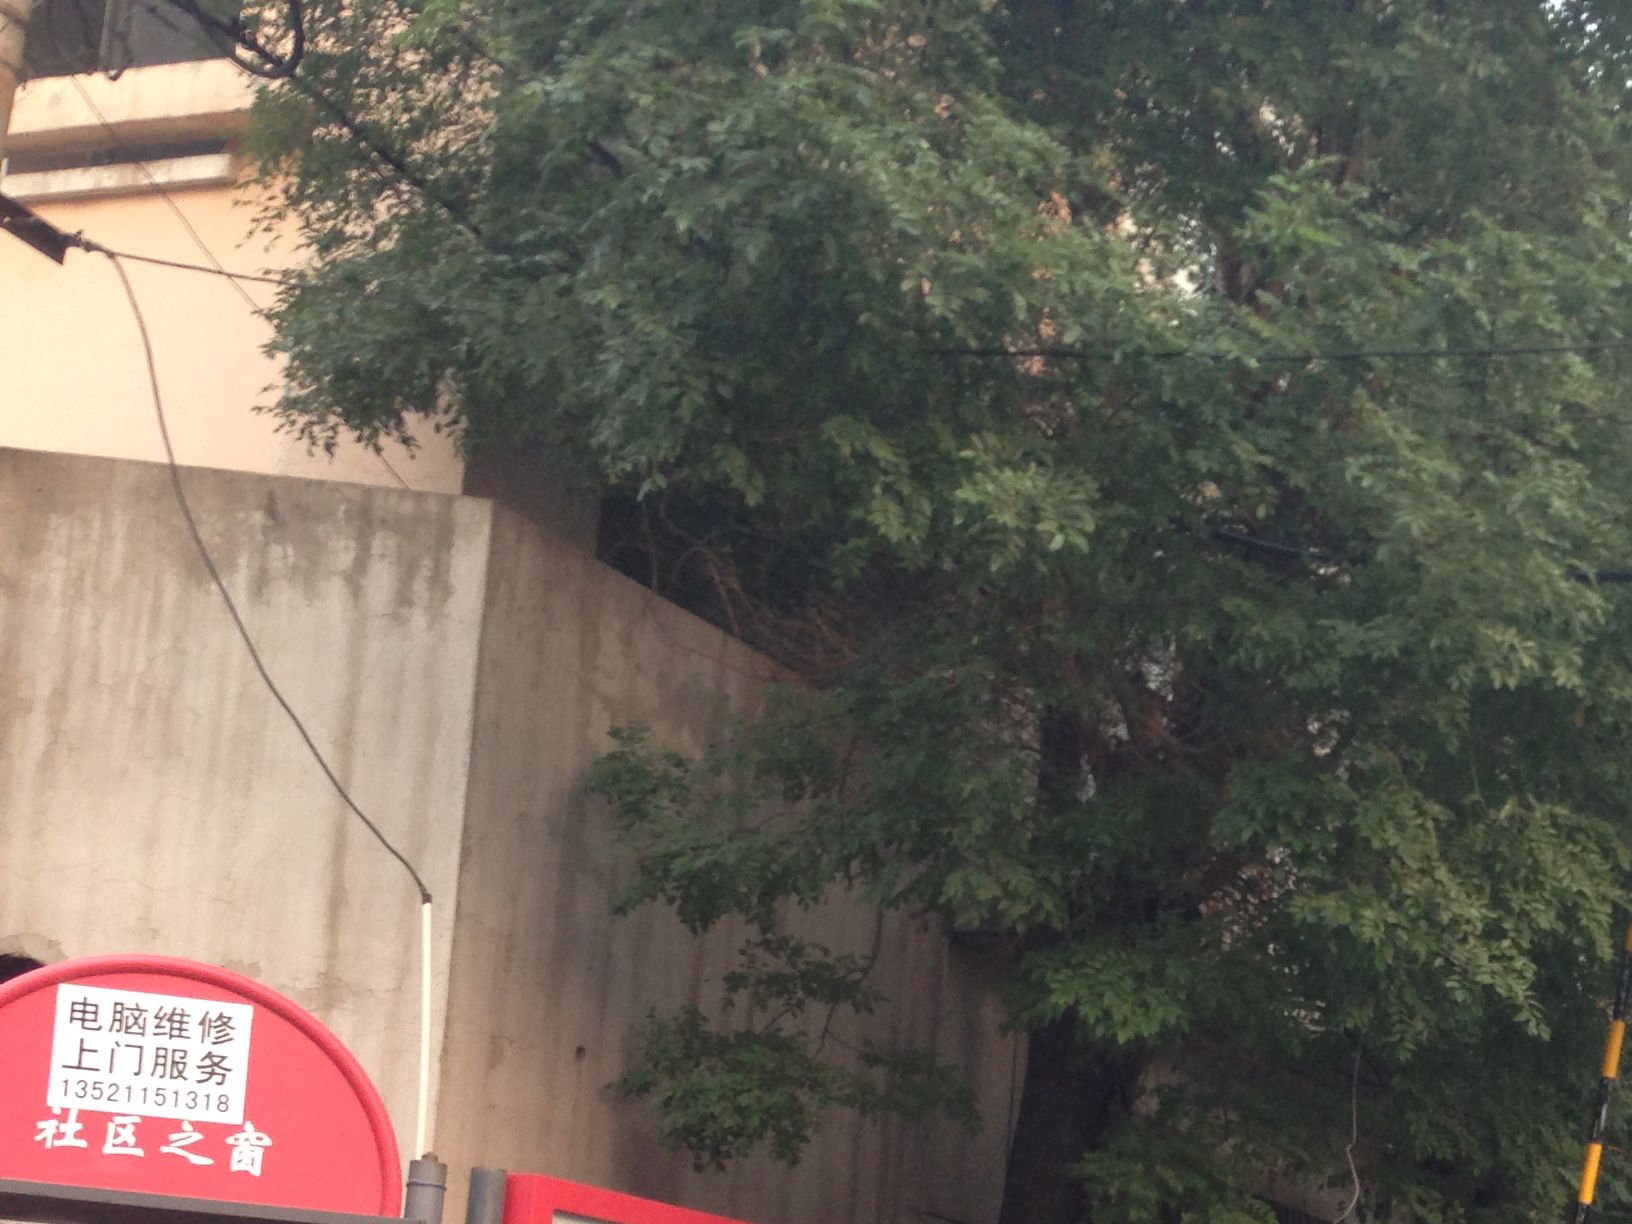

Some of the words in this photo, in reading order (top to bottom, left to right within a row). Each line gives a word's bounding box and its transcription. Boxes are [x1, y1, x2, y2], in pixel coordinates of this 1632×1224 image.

[69, 997, 237, 1046] 电脑维修
[62, 1038, 233, 1087] 上门服务
[62, 1079, 231, 1113] 13521151318
[34, 1107, 273, 1177] 社区之窗
